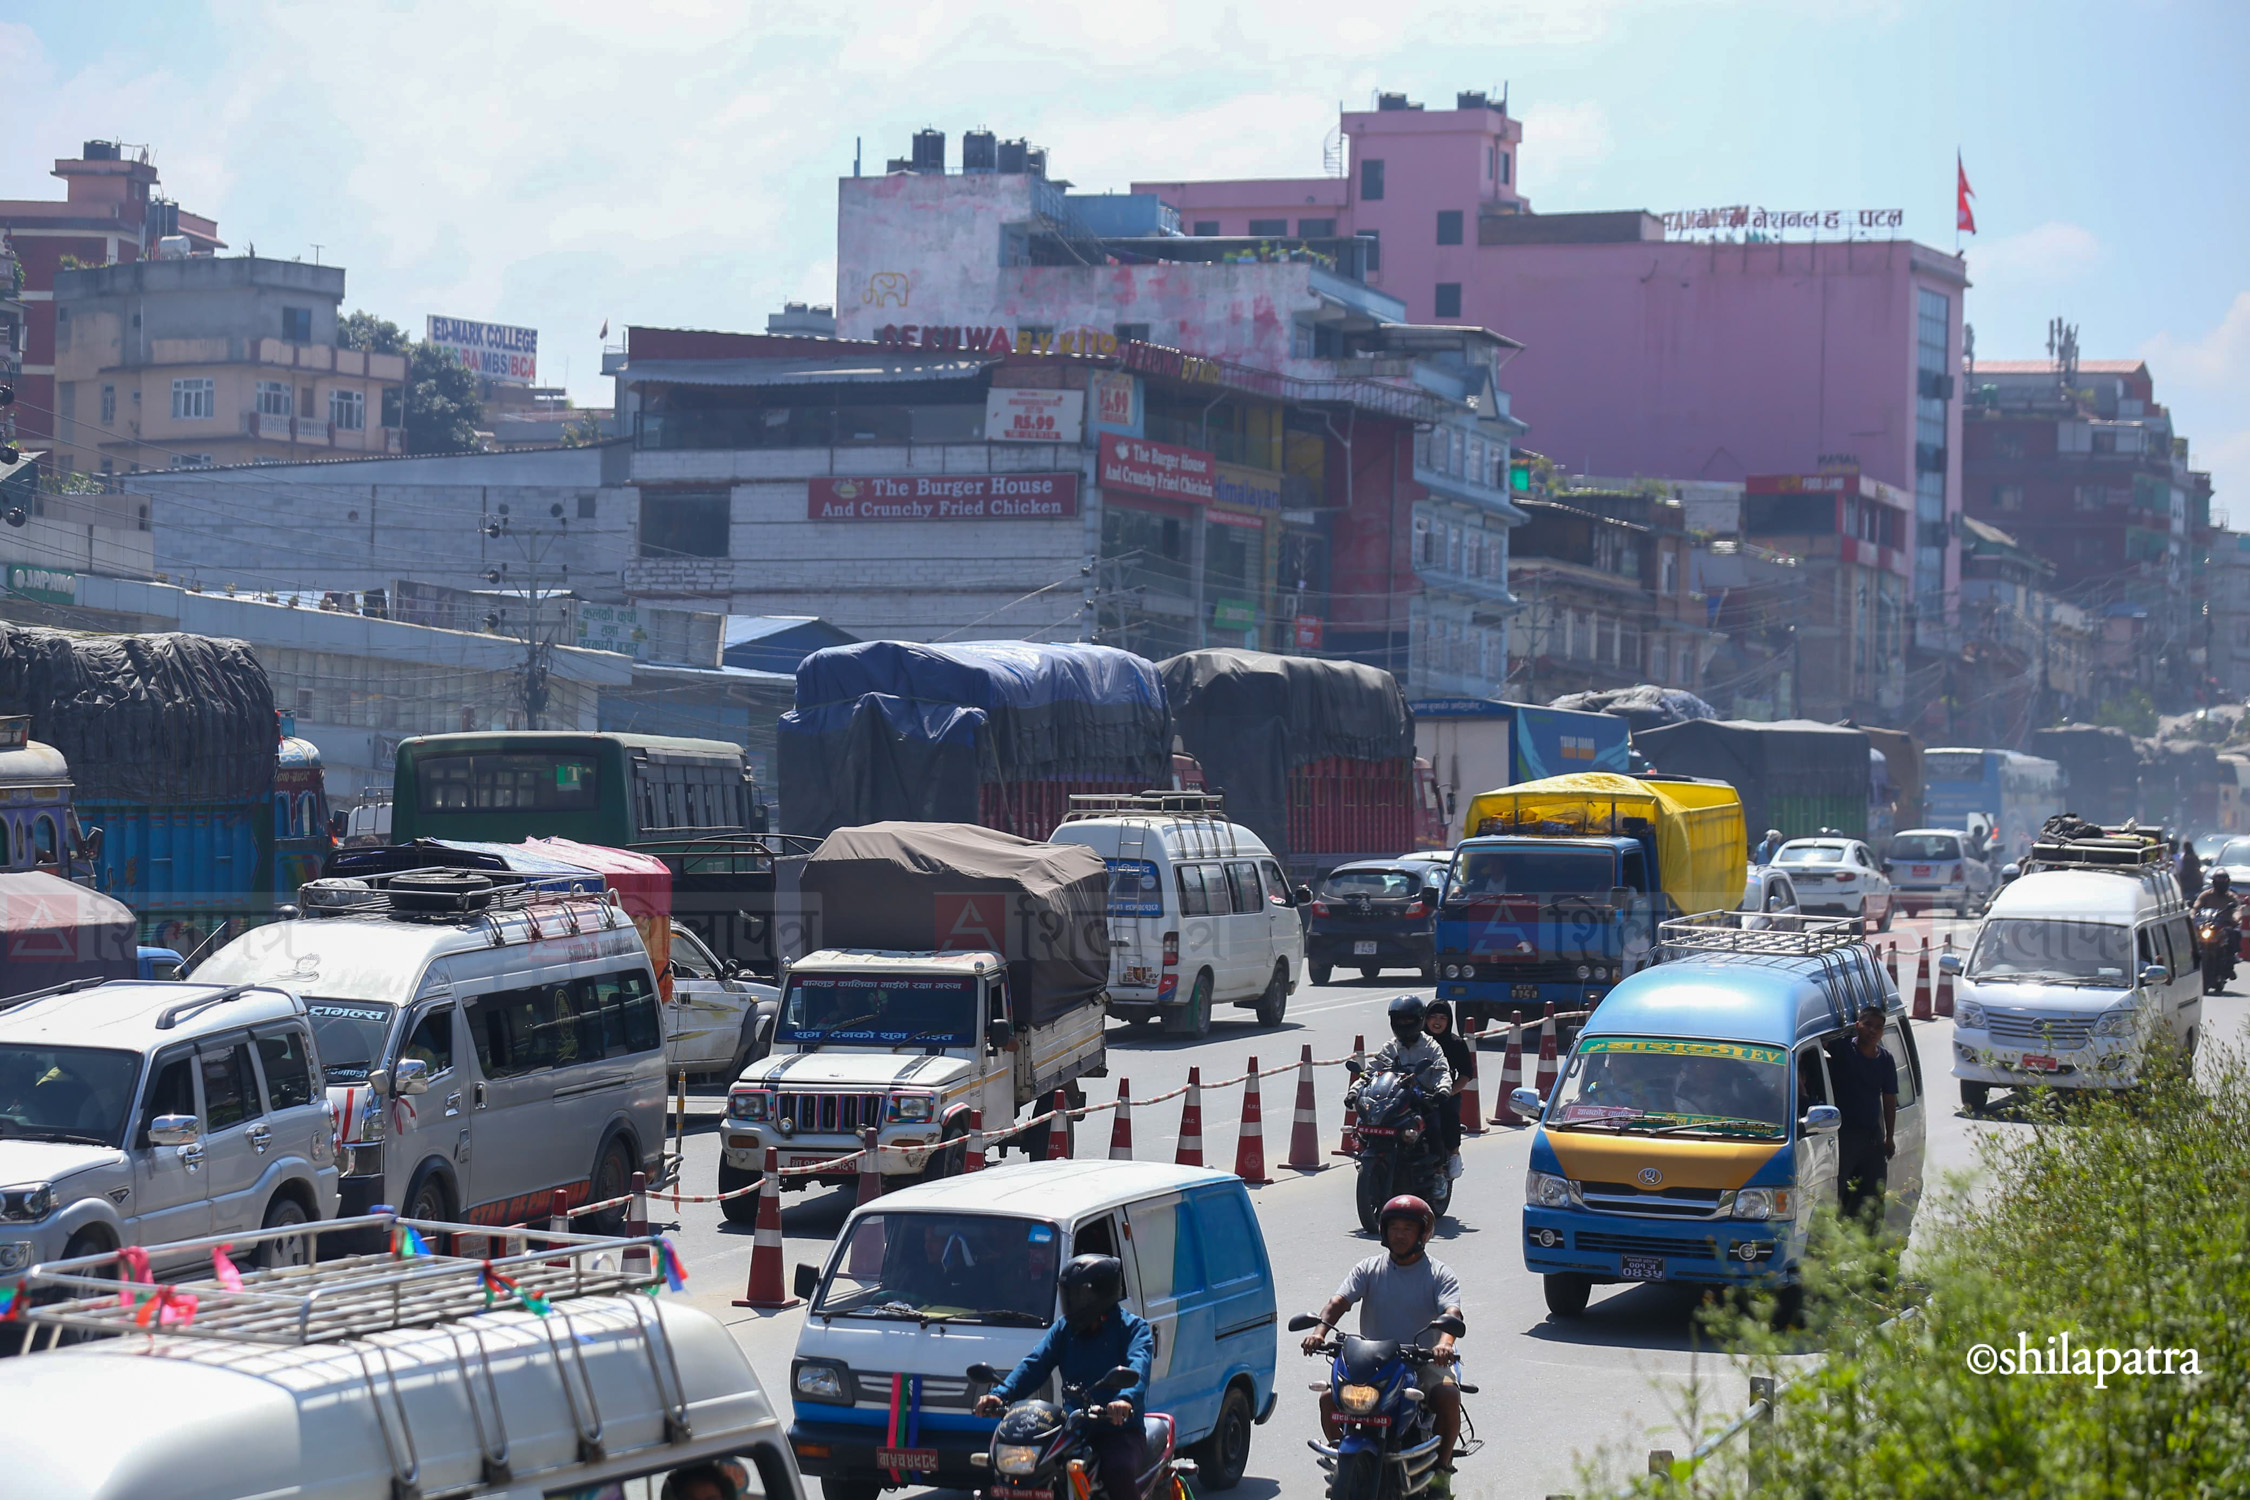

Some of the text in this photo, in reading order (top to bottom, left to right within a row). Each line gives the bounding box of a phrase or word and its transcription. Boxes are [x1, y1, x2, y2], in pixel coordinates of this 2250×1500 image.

[433, 318, 538, 354] ED-MARK COLLEGE
[883, 323, 1011, 355] SEKUWA
[1133, 444, 1207, 473] The Burger House
[872, 477, 1053, 498] The Burger House
[1105, 463, 1213, 498] And Crunchy Fried Chicken
[821, 499, 1062, 518] And Crunchy Fried Chicken
[25, 569, 67, 592] JAPAN
[837, 979, 877, 989] कालिका
[912, 981, 933, 990] रक्षा
[794, 1031, 821, 1039] शुभ
[880, 1031, 907, 1040] शुभ
[1749, 1049, 1782, 1062] EV
